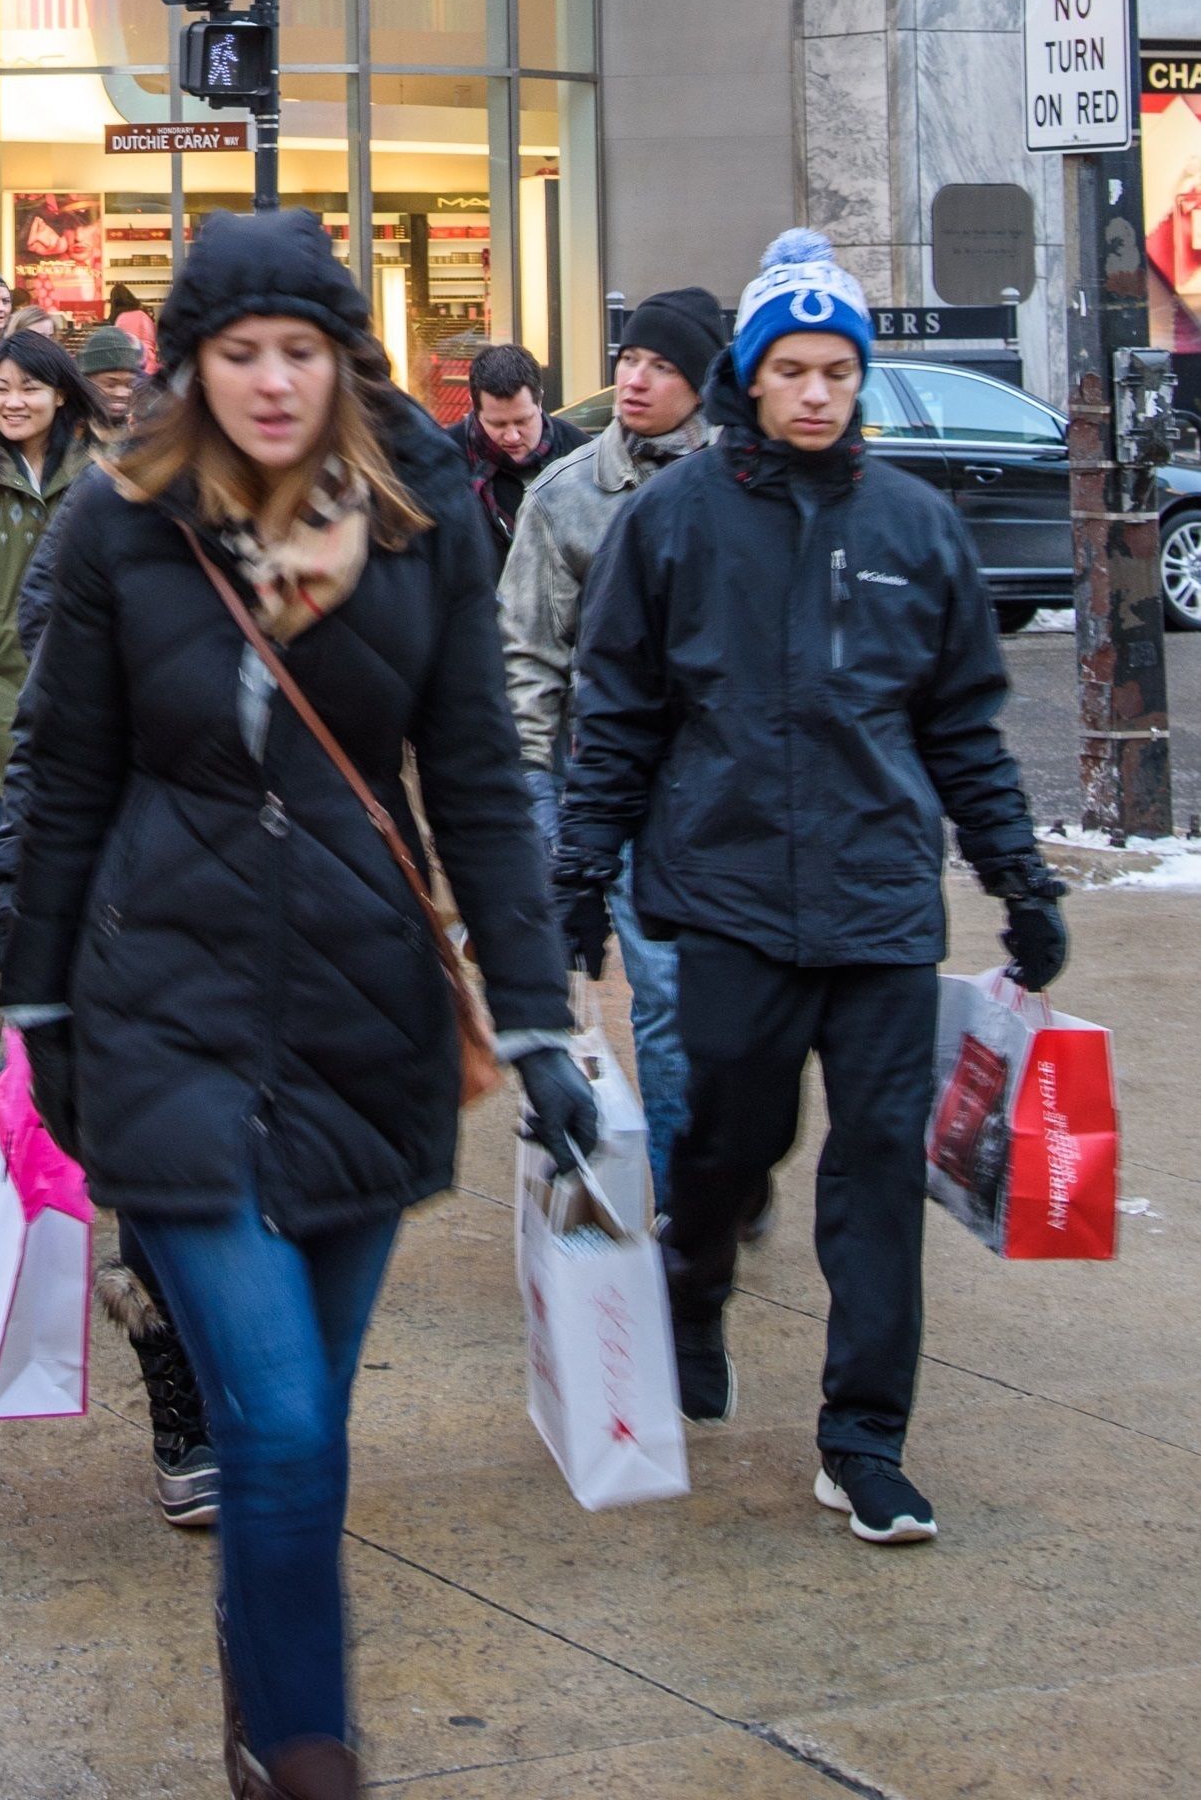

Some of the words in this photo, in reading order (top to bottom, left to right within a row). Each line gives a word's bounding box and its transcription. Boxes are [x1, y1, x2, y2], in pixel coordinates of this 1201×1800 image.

[1045, 37, 1105, 74] TURN
[1034, 93, 1062, 127] ON
[1077, 89, 1119, 125] RED
[112, 135, 170, 150] DUTCHIE
[174, 134, 220, 149] CARAY
[223, 136, 239, 146] WAY
[438, 198, 489, 208] MA
